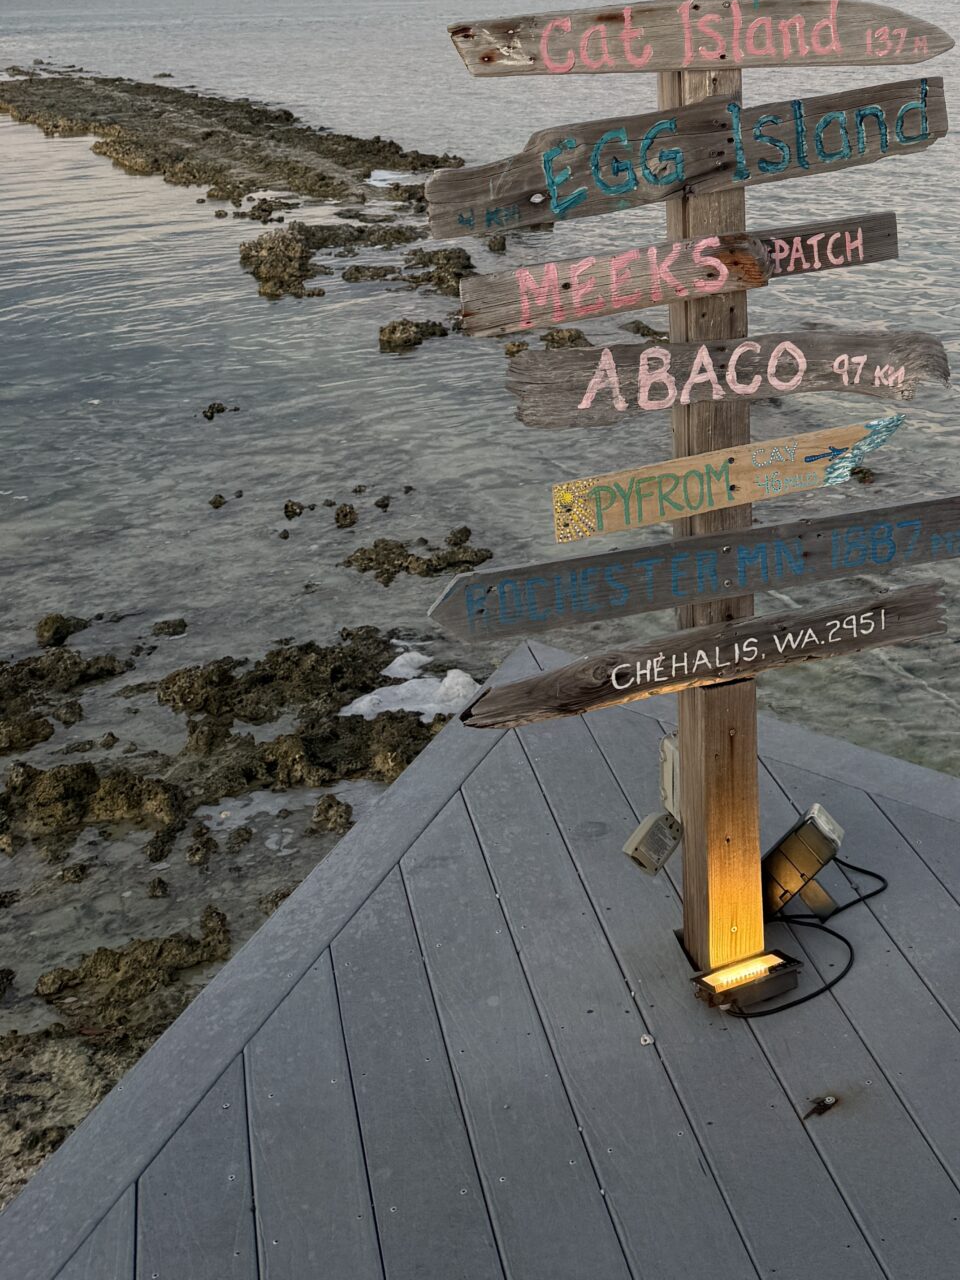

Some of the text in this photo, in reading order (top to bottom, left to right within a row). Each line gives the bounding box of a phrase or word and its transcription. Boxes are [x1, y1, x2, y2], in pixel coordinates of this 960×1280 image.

[540, 6, 654, 73] Cat
[865, 26, 908, 56] 137
[541, 78, 929, 214] EGG Island
[515, 227, 865, 327] MEEKS PATCH
[577, 340, 905, 411] ABACO 97 KM
[592, 440, 798, 531] PYFROM CAY
[753, 471, 782, 495] 46
[466, 550, 720, 628] ROCHESTER
[832, 518, 922, 569] 1887
